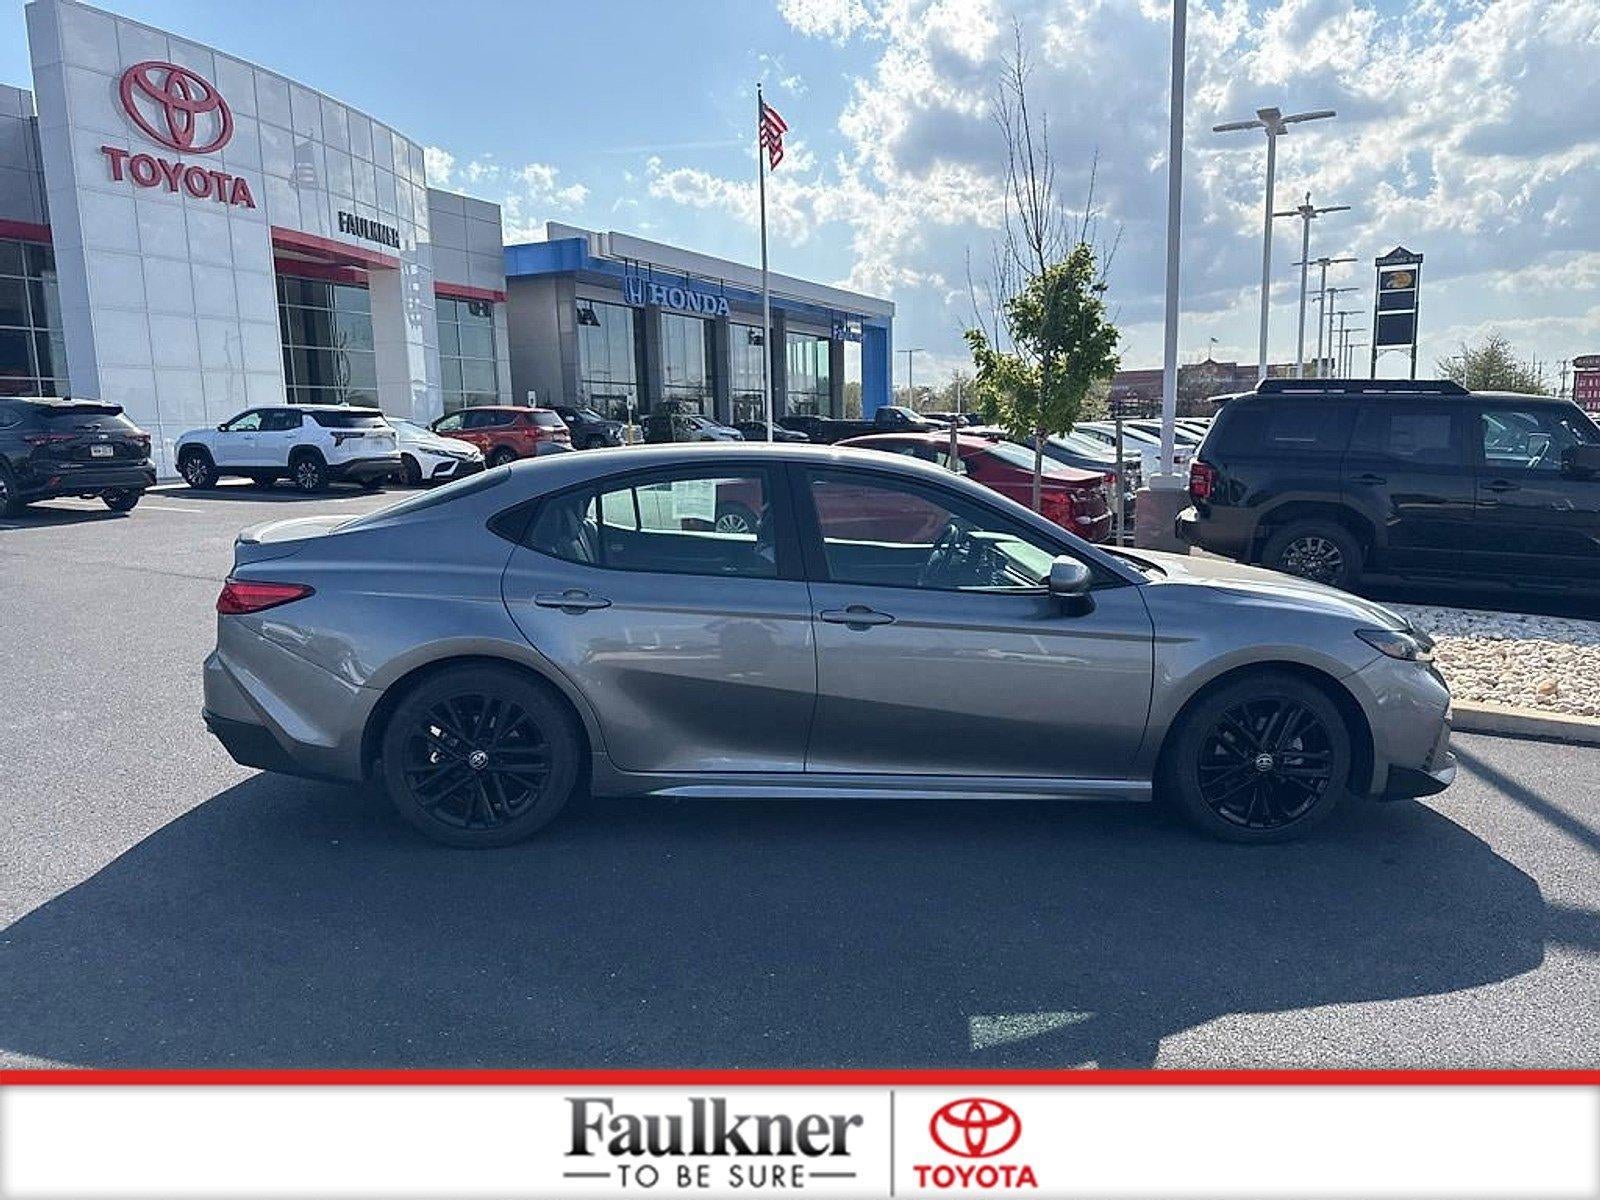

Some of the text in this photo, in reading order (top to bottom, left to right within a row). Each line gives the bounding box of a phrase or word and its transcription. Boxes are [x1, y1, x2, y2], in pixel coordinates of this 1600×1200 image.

[101, 146, 256, 209] TOYOTA
[338, 211, 400, 249] FAULKNER
[648, 282, 731, 317] HONDA
